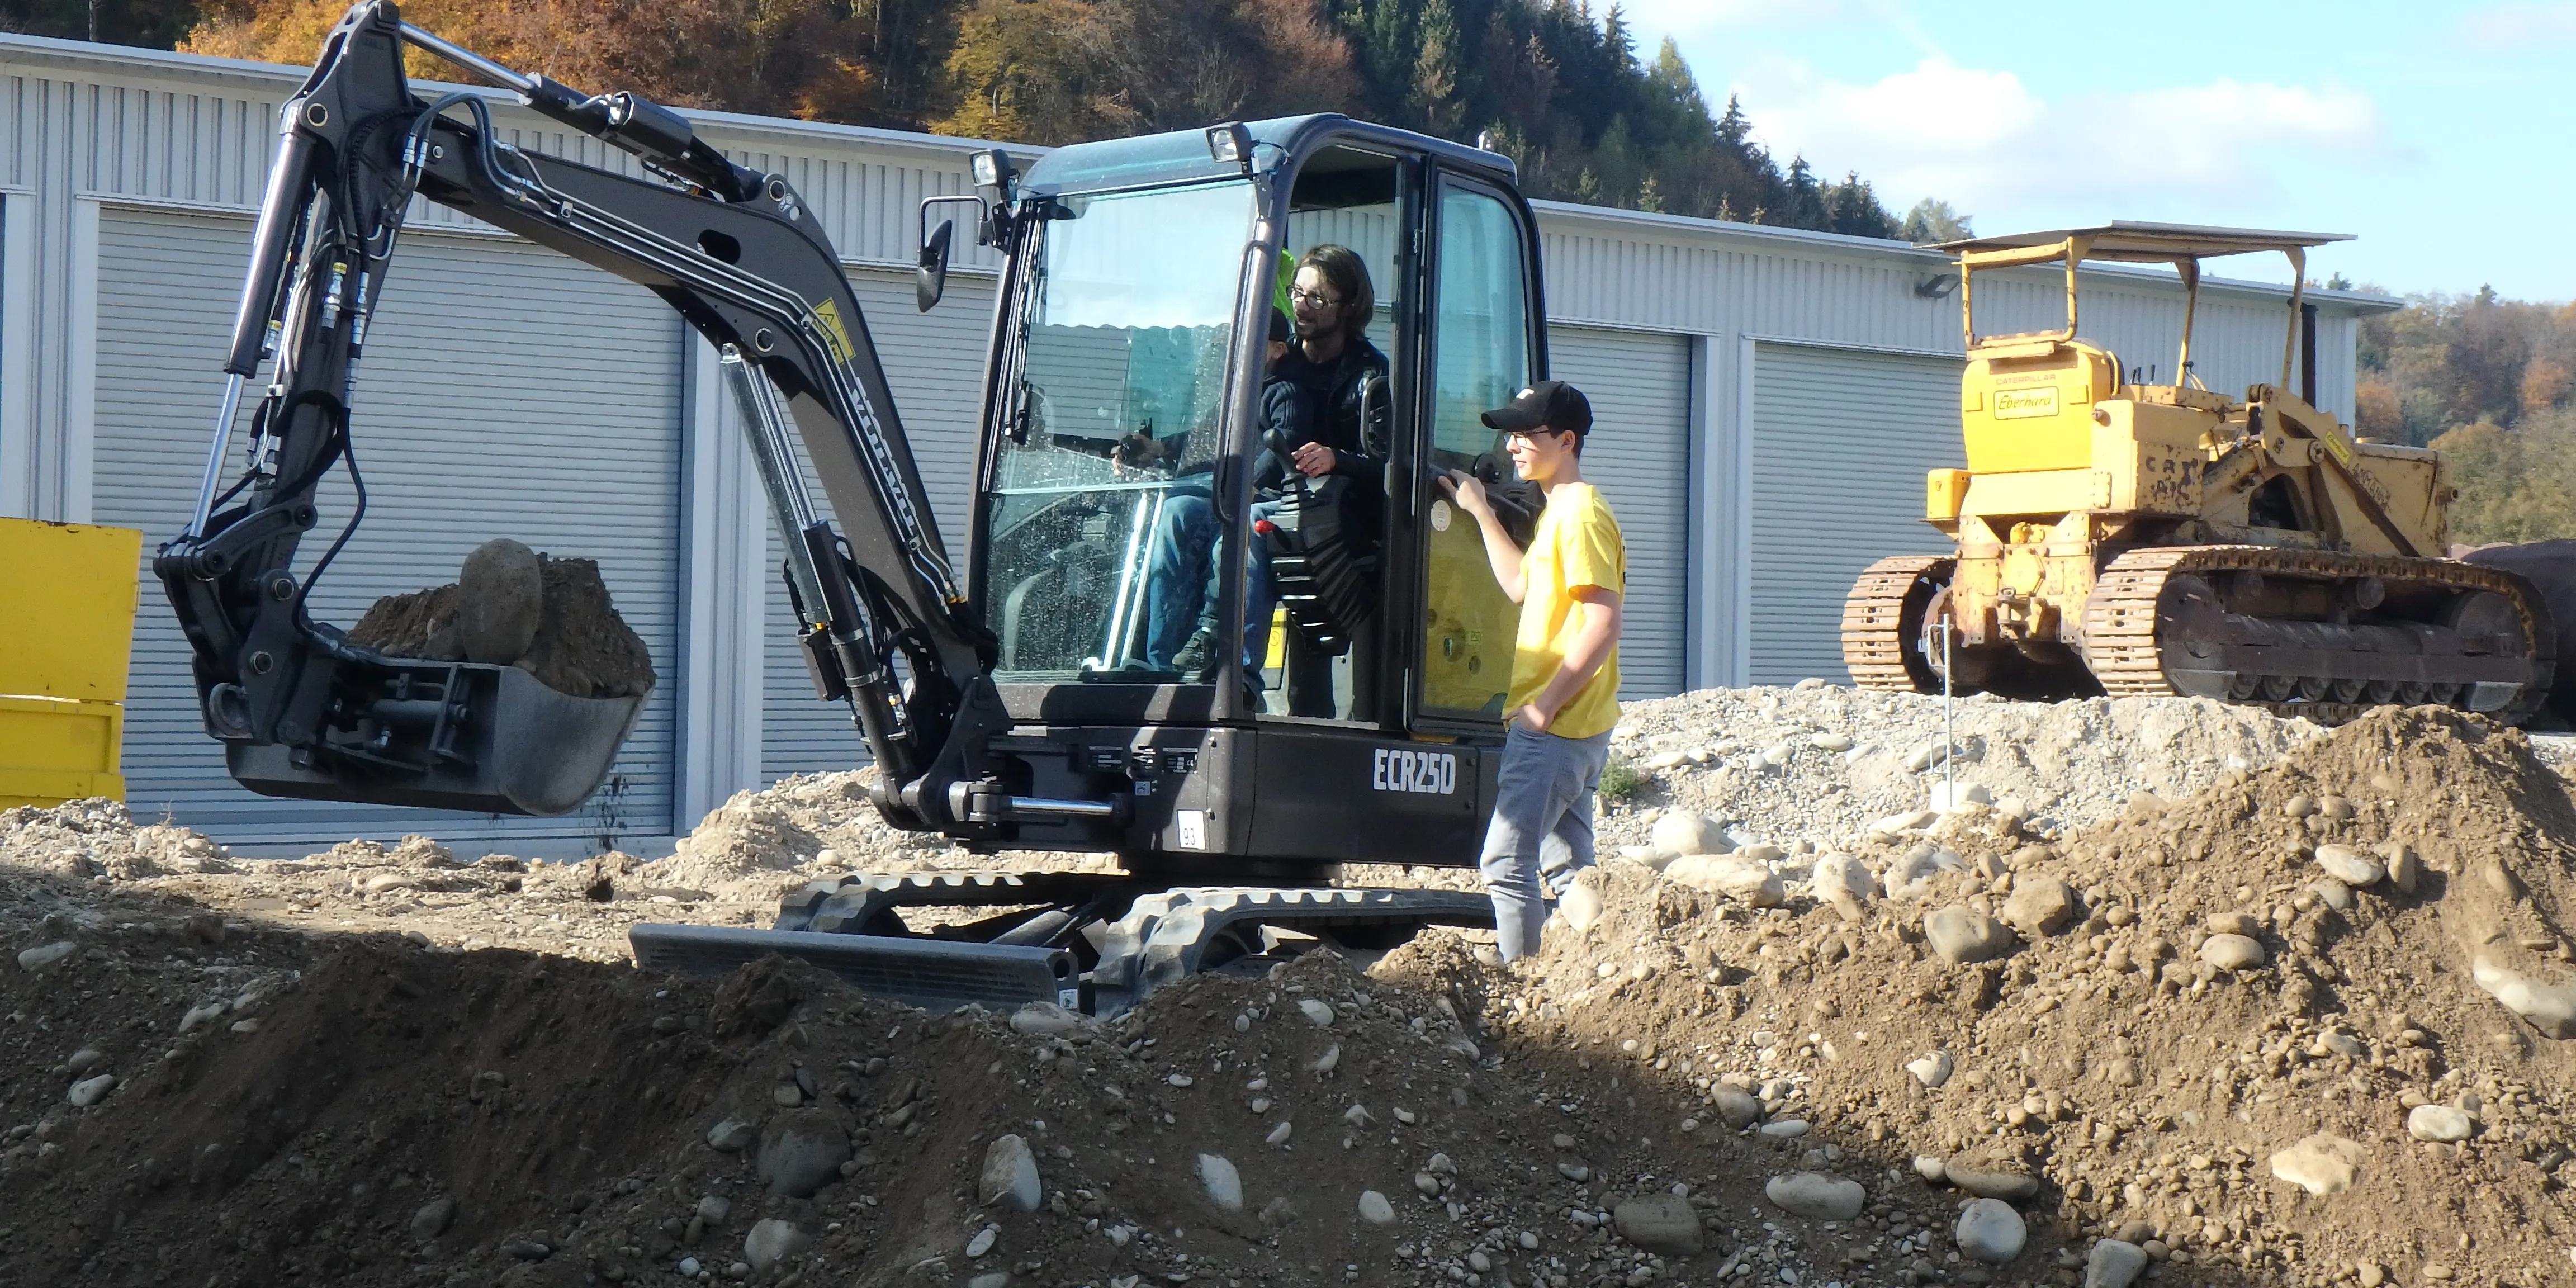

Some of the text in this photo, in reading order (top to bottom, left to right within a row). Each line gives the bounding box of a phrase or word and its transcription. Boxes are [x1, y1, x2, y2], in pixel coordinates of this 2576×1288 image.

[1996, 375, 2056, 385] CATERPILLAR
[1373, 749, 1456, 795] ECR25D
[1183, 827, 1196, 846] 93
